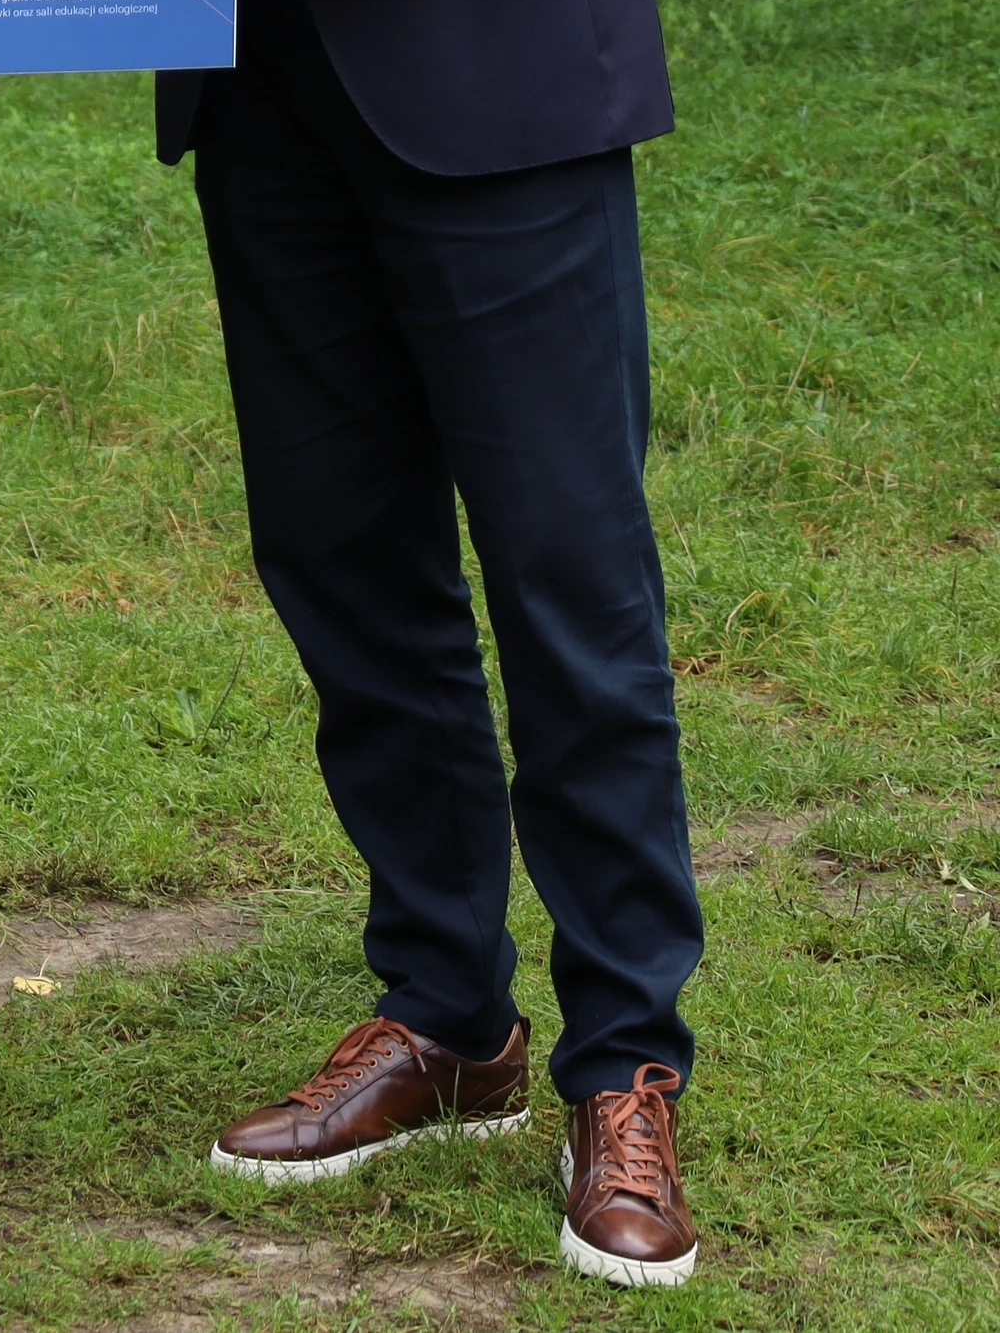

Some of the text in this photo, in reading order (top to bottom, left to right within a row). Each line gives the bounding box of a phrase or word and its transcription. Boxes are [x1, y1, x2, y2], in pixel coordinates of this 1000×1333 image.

[13, 8, 33, 17] oraz
[36, 6, 52, 16] sali
[55, 4, 95, 17] edukacji
[98, 3, 158, 16] ekologicznej
